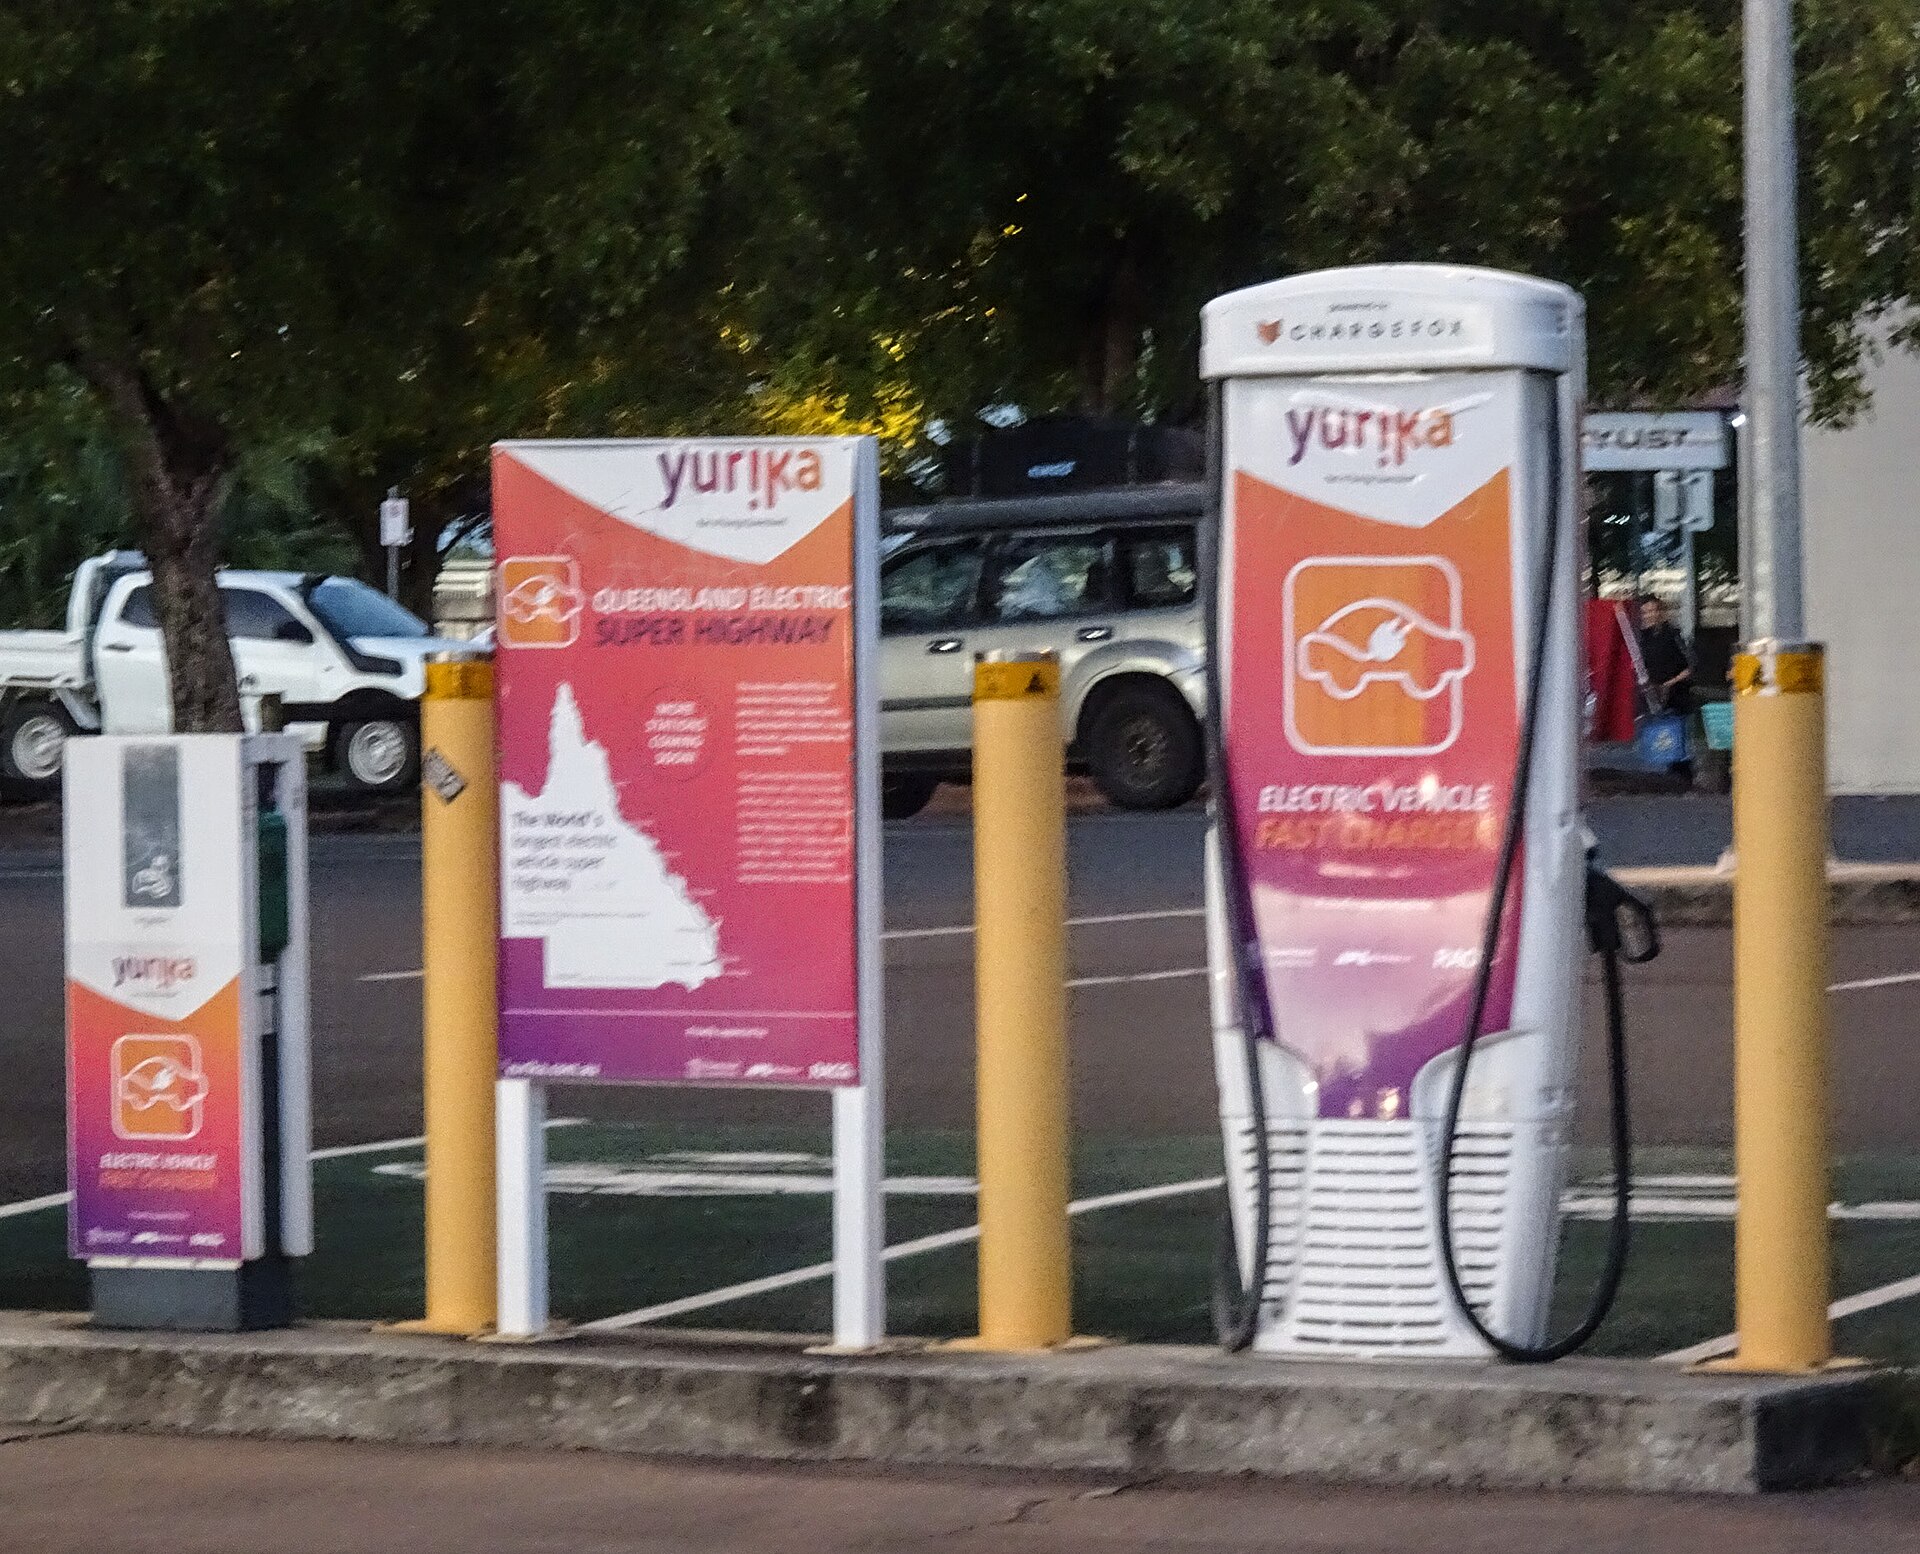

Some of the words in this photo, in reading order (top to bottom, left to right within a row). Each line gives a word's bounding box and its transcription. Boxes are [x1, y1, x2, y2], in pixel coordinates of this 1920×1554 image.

[1289, 316, 1464, 342] CHARGEFOX
[1284, 406, 1456, 467] yurika
[655, 447, 823, 510] yurika
[748, 584, 852, 610] ELECTRIC
[595, 616, 686, 647] SUPER
[695, 615, 835, 645] HIGHWAY
[1257, 784, 1382, 813] ELECTRIC
[1379, 784, 1494, 813] VEHICLE
